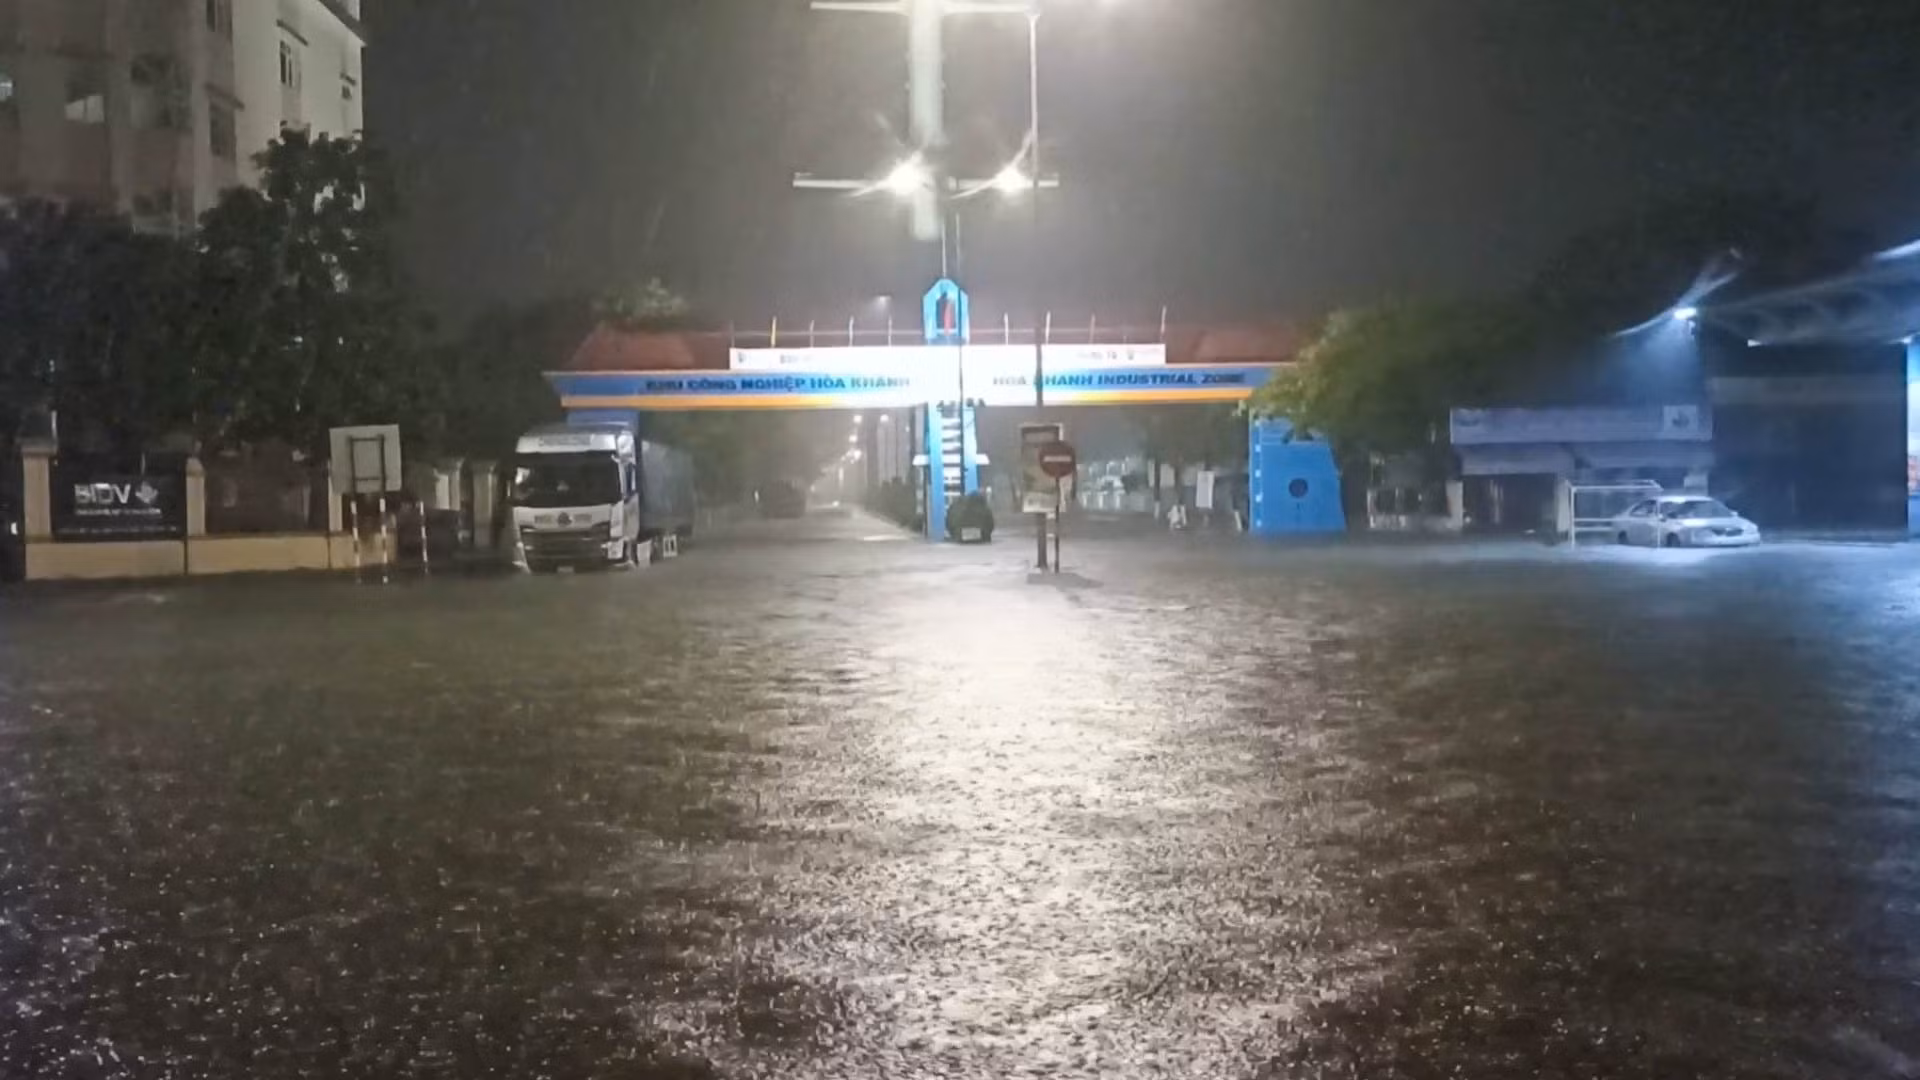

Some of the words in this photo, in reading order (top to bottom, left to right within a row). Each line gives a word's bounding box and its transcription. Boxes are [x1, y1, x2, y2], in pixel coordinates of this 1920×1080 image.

[740, 377, 805, 392] NGHIỆP
[810, 374, 846, 389] HÒA
[1034, 374, 1093, 387] HANH
[1097, 373, 1197, 386] INDUSTRIAL
[1201, 372, 1245, 384] ZONE
[74, 483, 131, 504] BIDV
